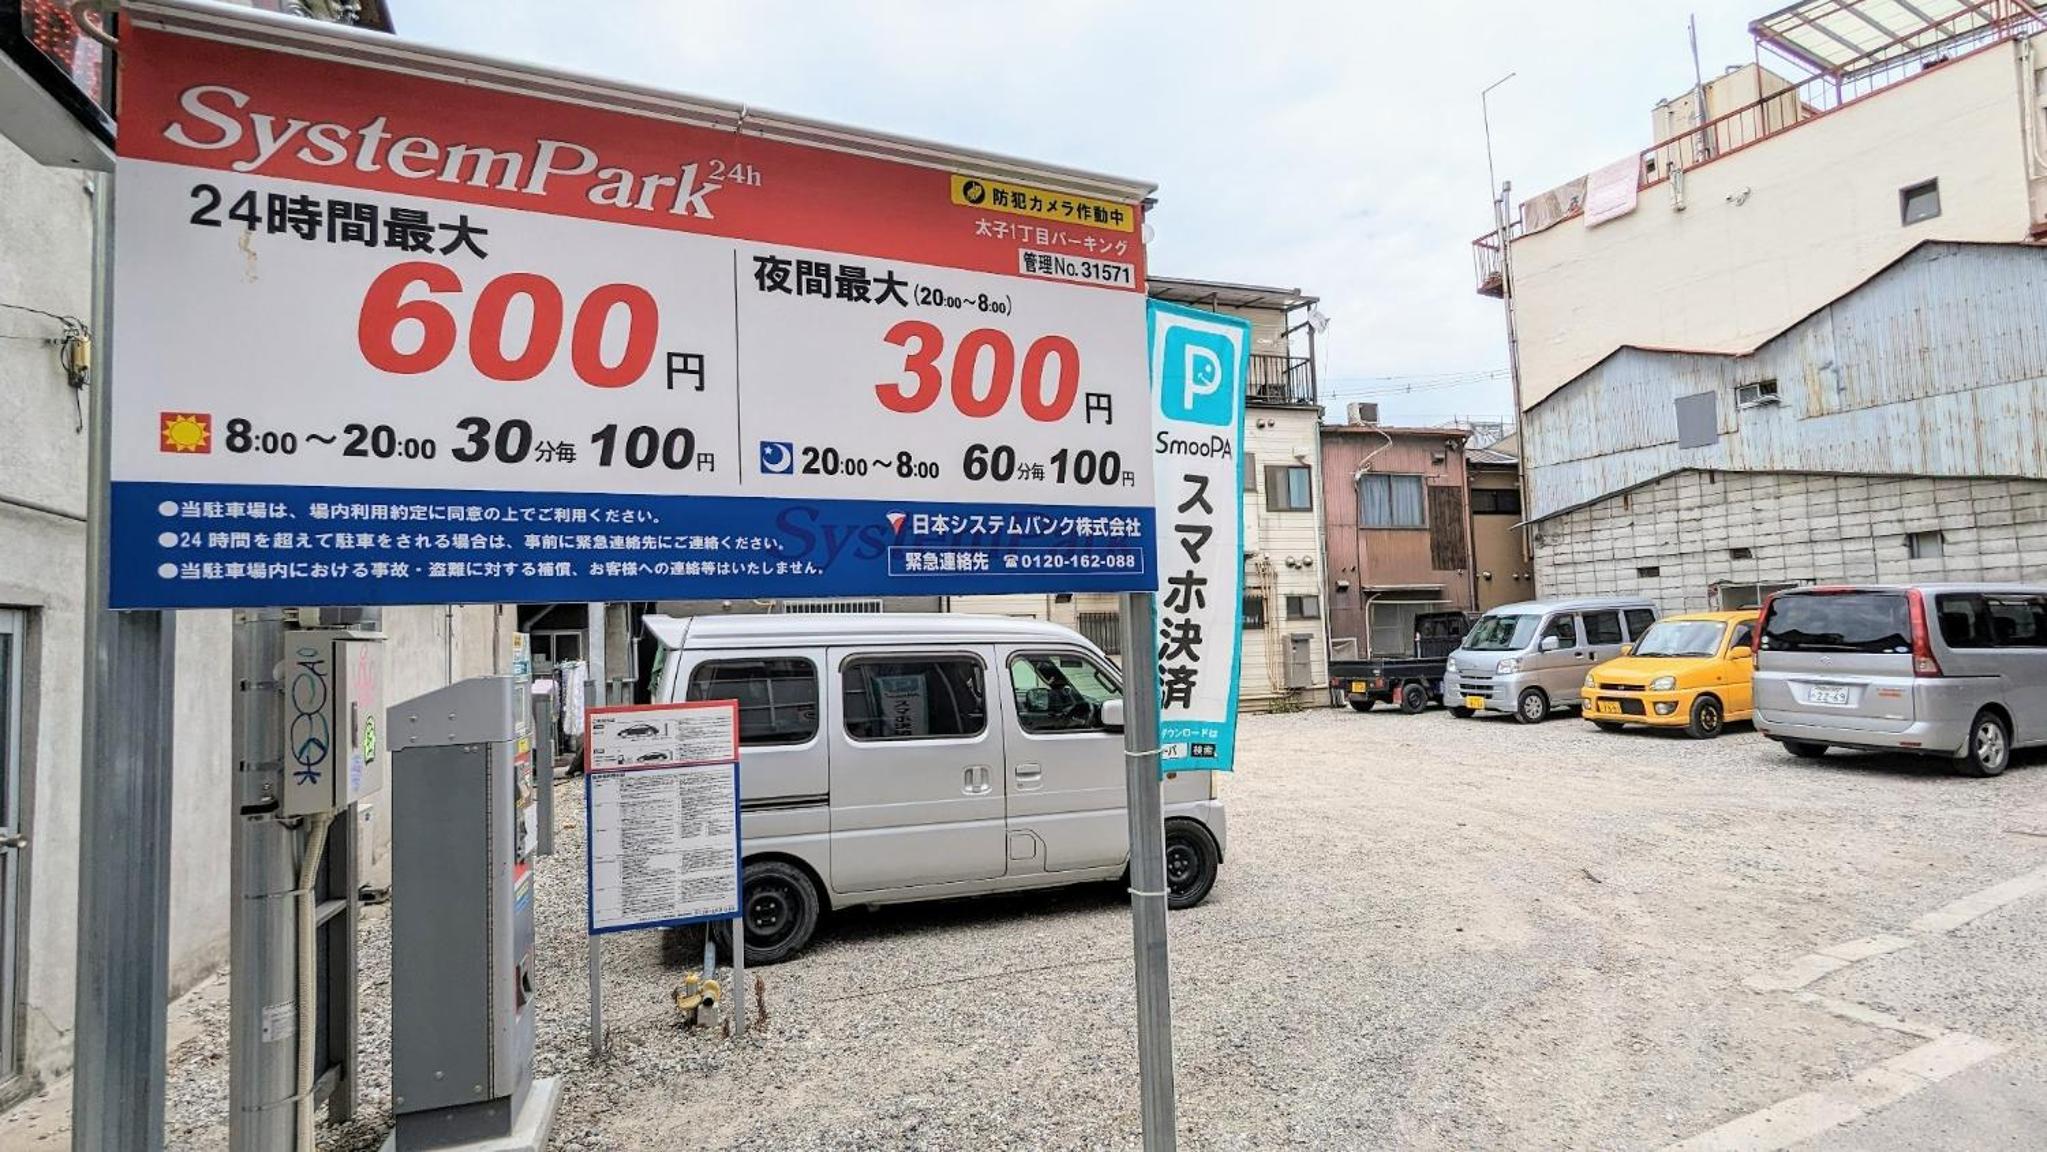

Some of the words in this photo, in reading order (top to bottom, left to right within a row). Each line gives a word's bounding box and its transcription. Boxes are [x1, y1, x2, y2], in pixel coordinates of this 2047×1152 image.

[163, 85, 722, 219] SystemPark
[708, 159, 761, 186] 24h
[190, 184, 488, 259] 24時間最大
[993, 188, 1123, 225] 防犯カメラ作動中
[1155, 431, 1232, 459] SmooPA
[912, 513, 1142, 538] 日本システムバンク株式会社
[905, 551, 990, 572] 緊急連絡先
[1158, 474, 1213, 710] スマホ決済
